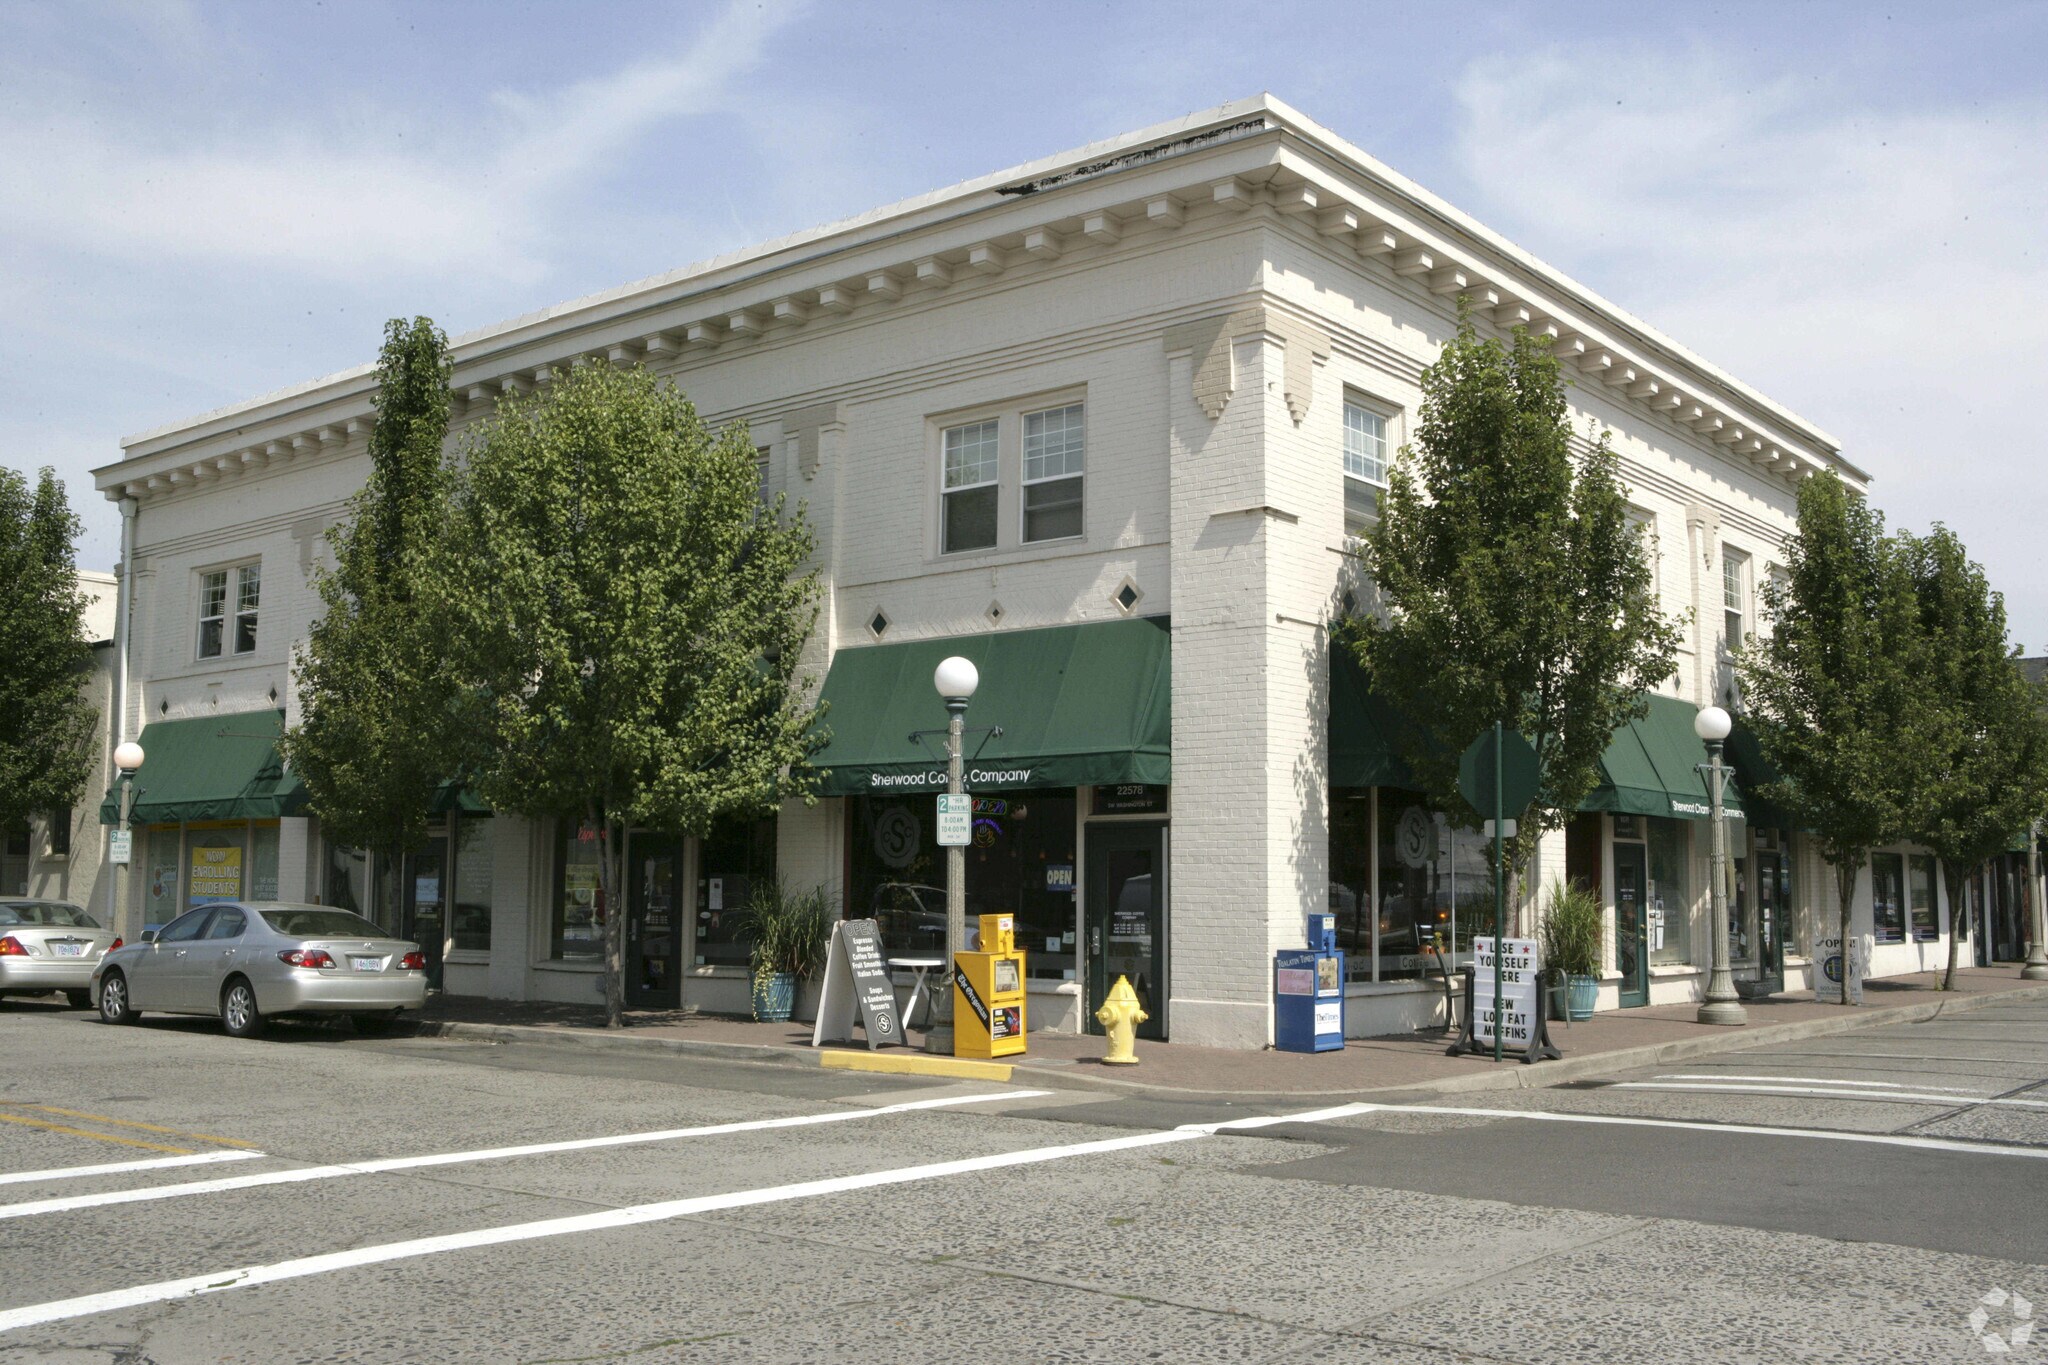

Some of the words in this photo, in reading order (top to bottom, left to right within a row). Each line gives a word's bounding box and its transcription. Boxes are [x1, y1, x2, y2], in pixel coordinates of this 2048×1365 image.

[871, 772, 926, 786] Sherwood
[970, 769, 1031, 784] Company
[1117, 785, 1144, 796] 22578
[939, 798, 948, 811] 2
[1672, 800, 1695, 813] Sherwood
[111, 832, 118, 842] 2
[206, 850, 226, 862] NOW
[192, 865, 240, 879] ENROLLING
[1047, 869, 1073, 885] OPEN
[192, 881, 239, 895] STUDENTS!
[845, 922, 875, 937] OPEN
[856, 945, 874, 953] Blended
[1490, 943, 1514, 954] LSE
[1300, 954, 1314, 964] TIMES
[1480, 956, 1529, 969] YOUSELF
[1501, 971, 1520, 983] ERE
[869, 987, 883, 995] Soups
[957, 973, 968, 989] The
[965, 987, 988, 1021] Oregonian
[867, 994, 894, 1003] Sandwiches
[870, 1003, 890, 1011] Desserts
[1484, 1011, 1504, 1022] LO
[1508, 1013, 1526, 1025] FAT
